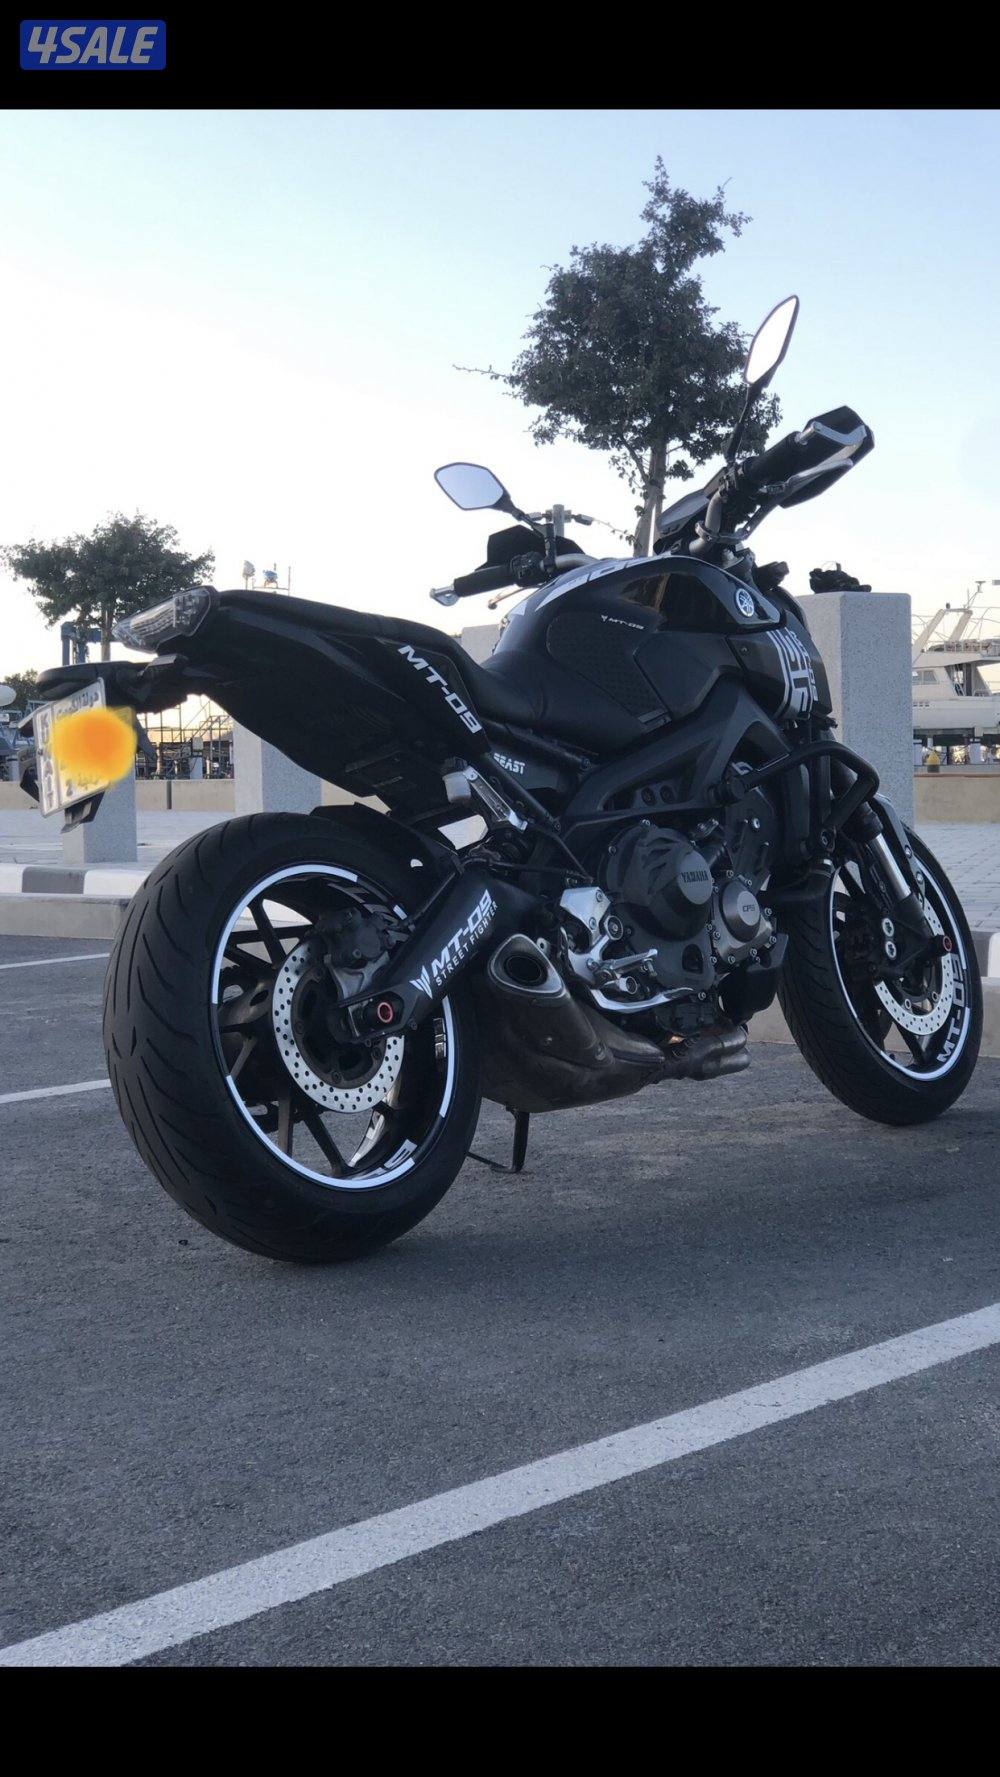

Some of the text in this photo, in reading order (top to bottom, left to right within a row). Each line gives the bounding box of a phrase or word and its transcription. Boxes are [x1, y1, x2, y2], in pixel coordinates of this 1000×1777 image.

[398, 645, 482, 733] MT-09
[681, 870, 709, 883] YAMAHA
[431, 889, 492, 978] MT-09
[435, 901, 498, 986] STREET FIGHTER
[936, 953, 965, 1062] MT-09
